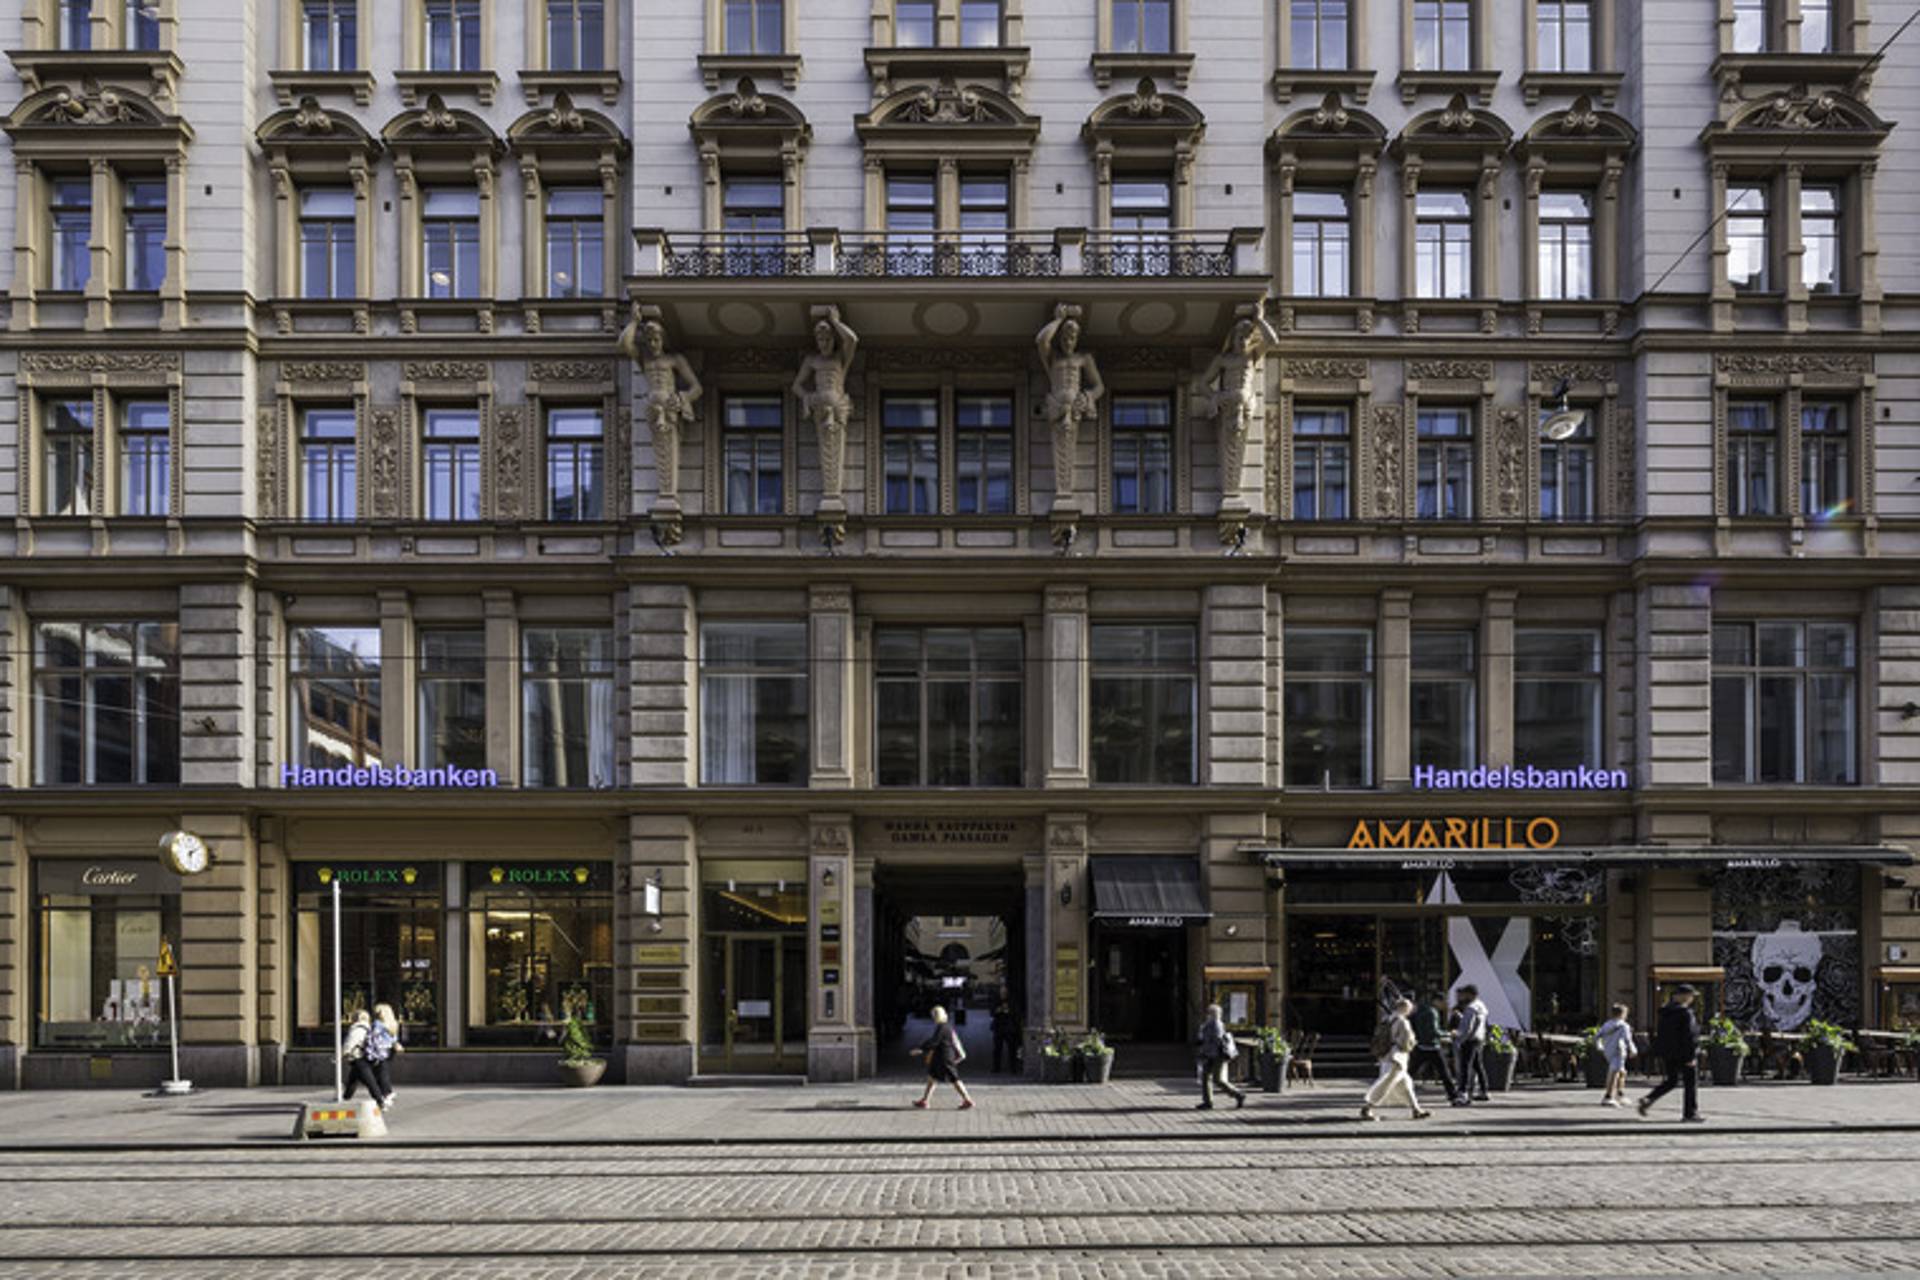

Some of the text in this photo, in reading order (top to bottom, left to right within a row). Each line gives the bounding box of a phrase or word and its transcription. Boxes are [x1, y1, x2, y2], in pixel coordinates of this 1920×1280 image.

[280, 763, 497, 787] Handelsbanken
[1413, 765, 1627, 788] Handelsbanken
[1348, 817, 1560, 849] AMARILLO
[82, 866, 138, 885] Cartier
[337, 868, 398, 883] ROLEX
[509, 868, 570, 883] ROLEX
